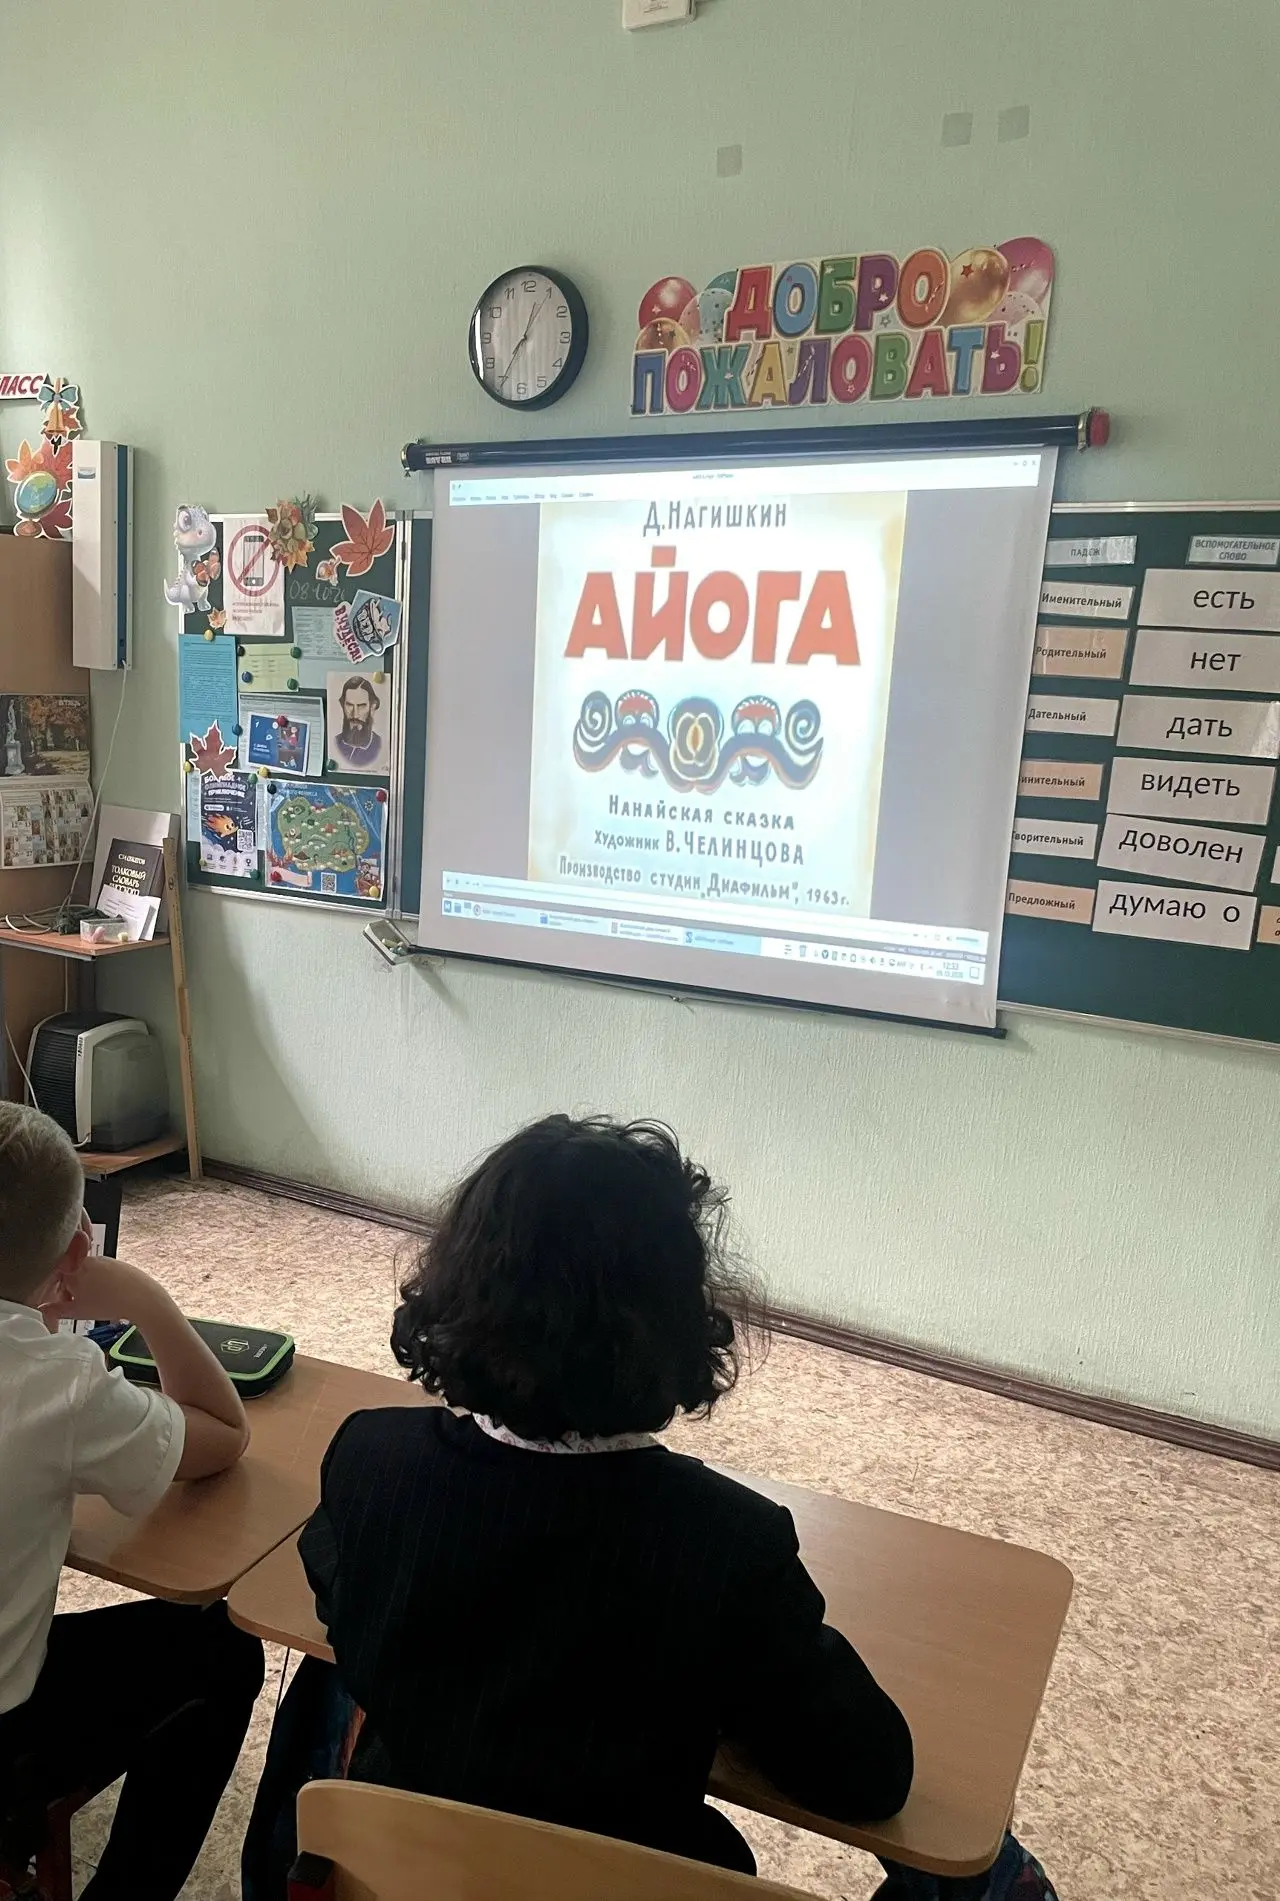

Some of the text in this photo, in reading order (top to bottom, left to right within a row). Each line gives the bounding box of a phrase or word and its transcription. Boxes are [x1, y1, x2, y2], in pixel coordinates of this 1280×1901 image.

[504, 287, 515, 300] 11
[521, 280, 537, 293] 12
[545, 286, 553, 299] 1
[725, 249, 950, 343] ДОБРО
[488, 306, 502, 319] 10
[556, 306, 568, 318] 2
[481, 332, 491, 344] 9
[560, 331, 571, 344] 3
[485, 357, 495, 369] 8
[551, 357, 563, 368] 4
[631, 319, 1046, 416] ПОЖАЛОВАТЬ!
[0, 375, 43, 396] ЛАСС
[498, 375, 509, 388] 7
[536, 376, 547, 388] 5
[516, 383, 527, 395] 6
[1194, 537, 1276, 551] ВСПОМОГАТЕЛЬНОЕ
[1218, 551, 1247, 561] СЛОВО
[563, 545, 861, 666] АЙОГА
[1042, 592, 1122, 608] Именительный
[1193, 589, 1255, 610] есть
[1035, 646, 1107, 660] Родительный
[1190, 651, 1241, 672] нет
[1028, 708, 1086, 722] Дательный
[1165, 715, 1233, 740] дать
[1019, 776, 1085, 786] инительный
[1141, 773, 1241, 799] видеть
[1118, 828, 1244, 864] доволен
[1008, 892, 1076, 910] Предложный
[1109, 892, 1240, 923] думаю о
